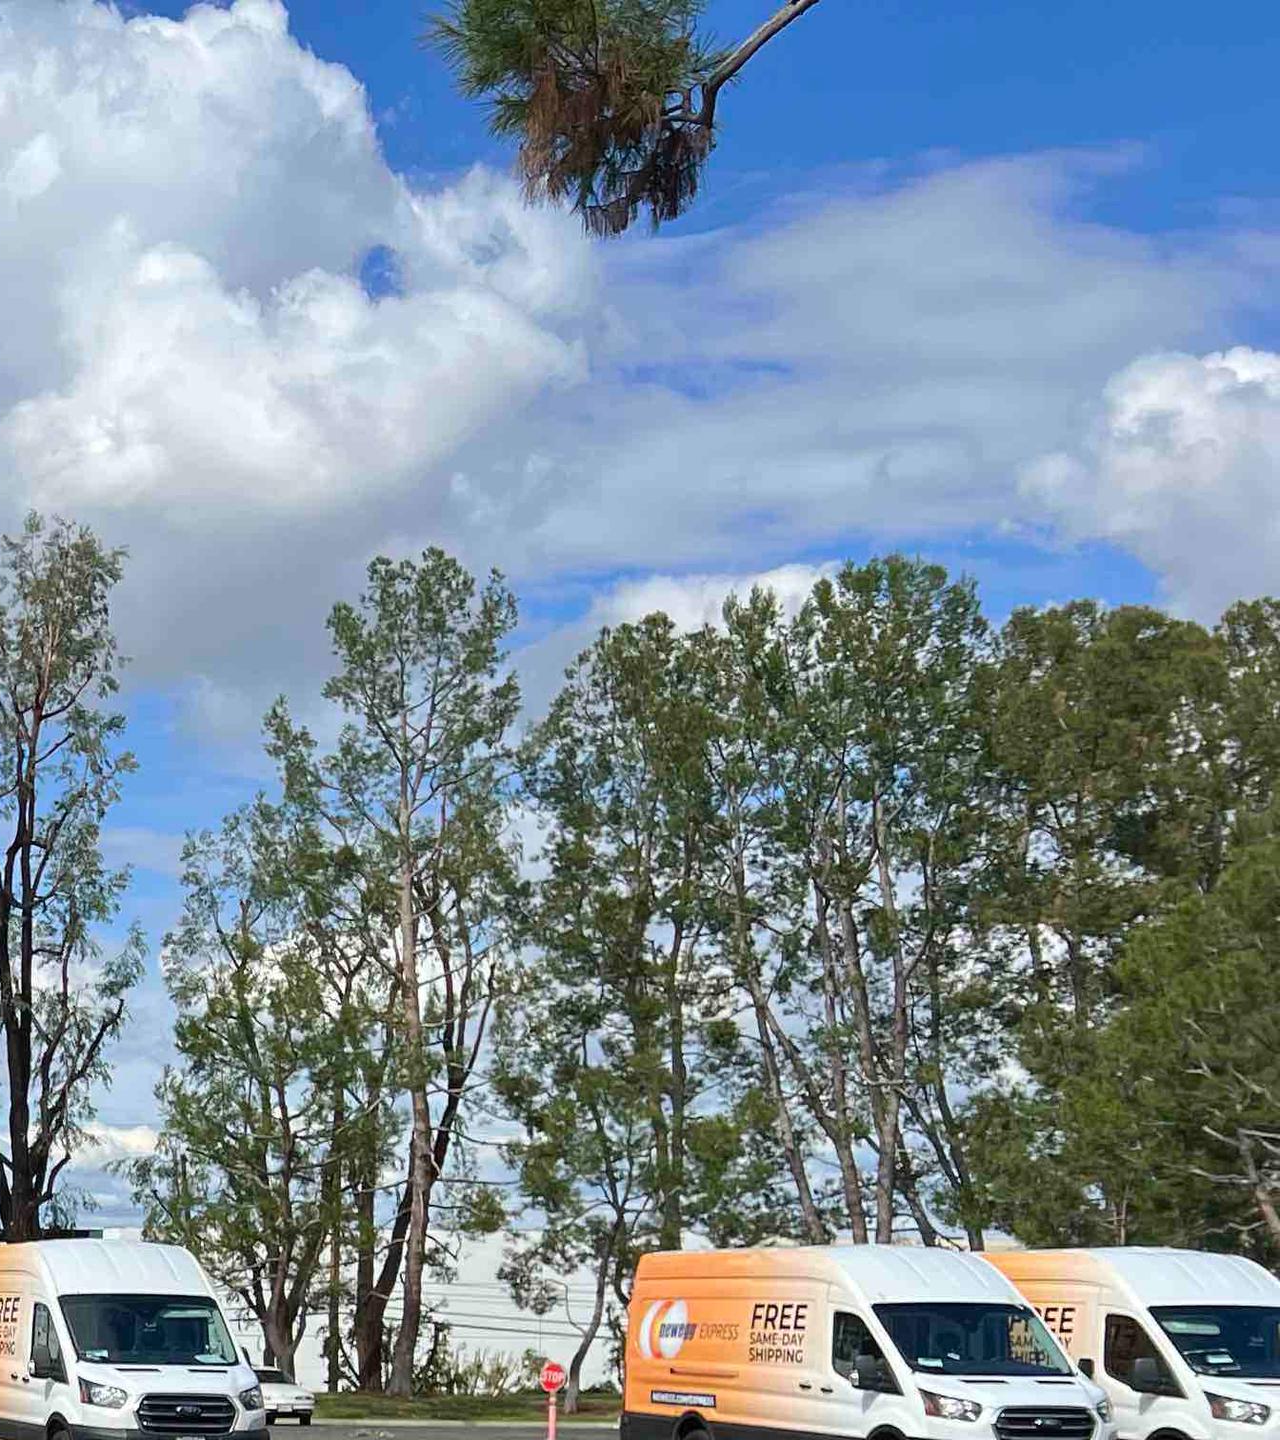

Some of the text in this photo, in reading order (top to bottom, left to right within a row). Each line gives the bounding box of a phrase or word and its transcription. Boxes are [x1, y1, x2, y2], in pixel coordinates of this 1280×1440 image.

[750, 1303, 808, 1330] FREE
[659, 1322, 740, 1341] newegg EXPRESS
[749, 1331, 805, 1347] SAME-DAY
[748, 1346, 803, 1364] SHIPPING
[541, 1371, 565, 1382] STOP
